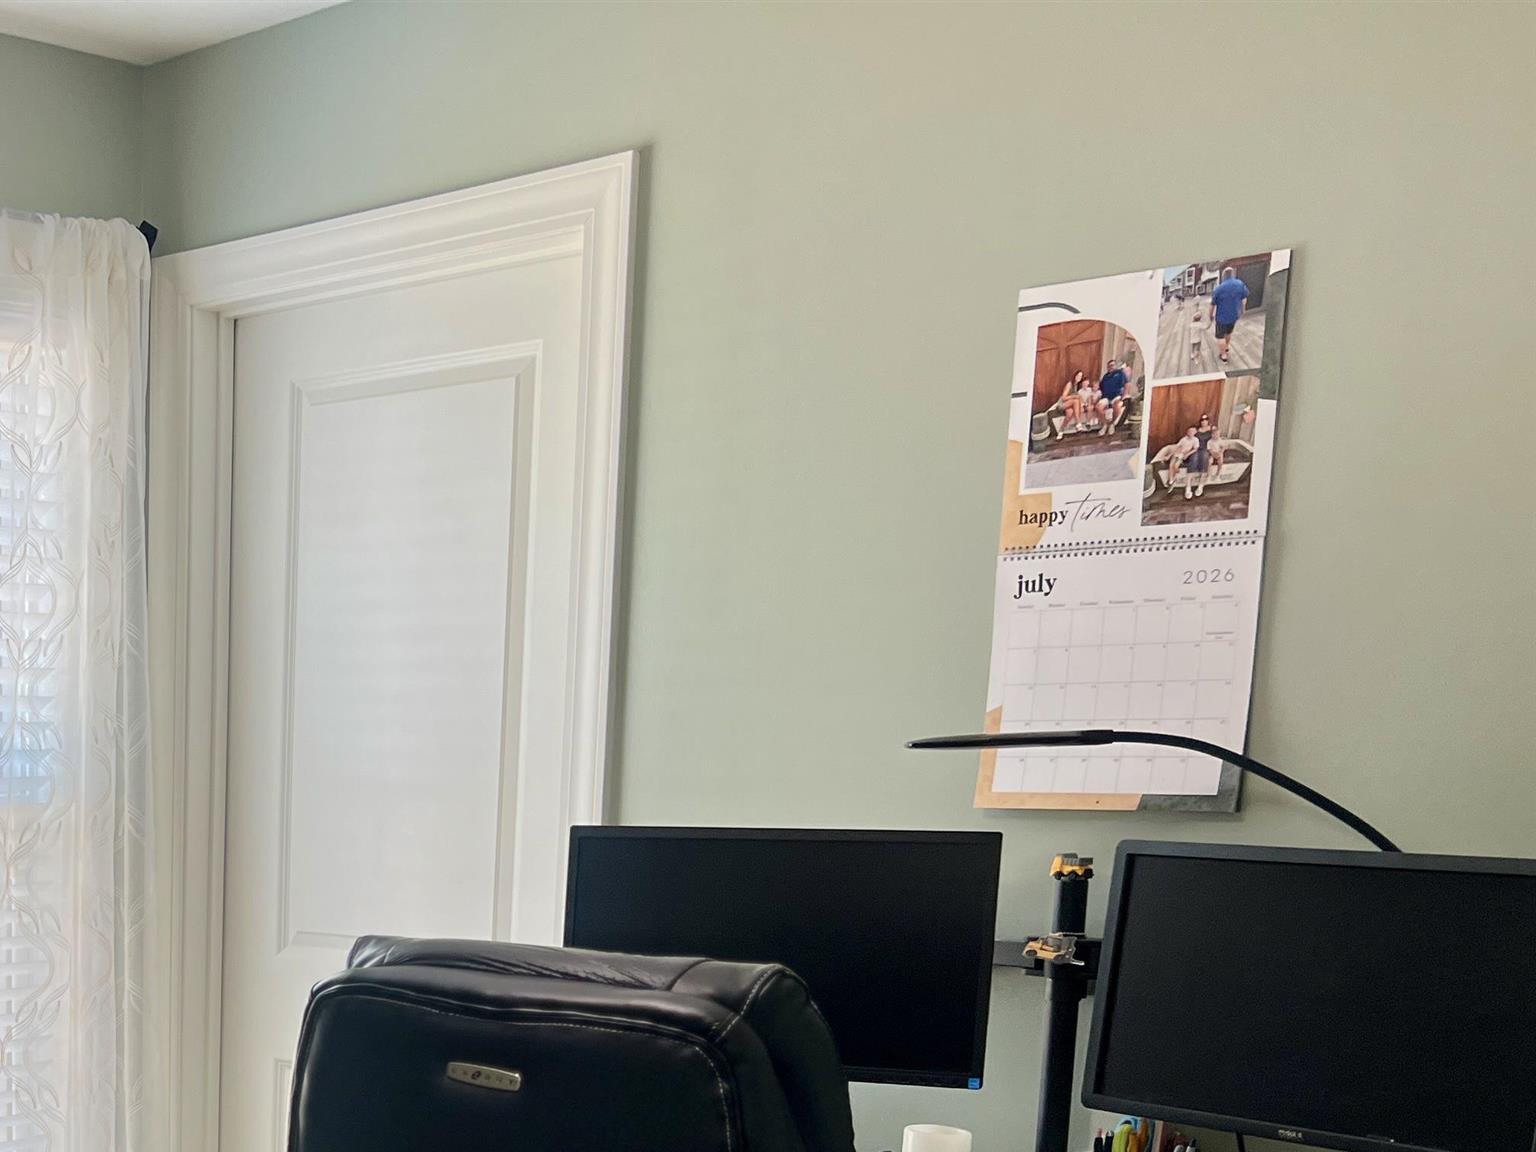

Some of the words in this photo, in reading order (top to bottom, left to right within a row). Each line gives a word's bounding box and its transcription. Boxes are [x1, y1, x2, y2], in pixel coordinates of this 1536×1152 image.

[1018, 509, 1068, 528] happy
[1013, 573, 1057, 599] july
[1183, 568, 1234, 584] 2026
